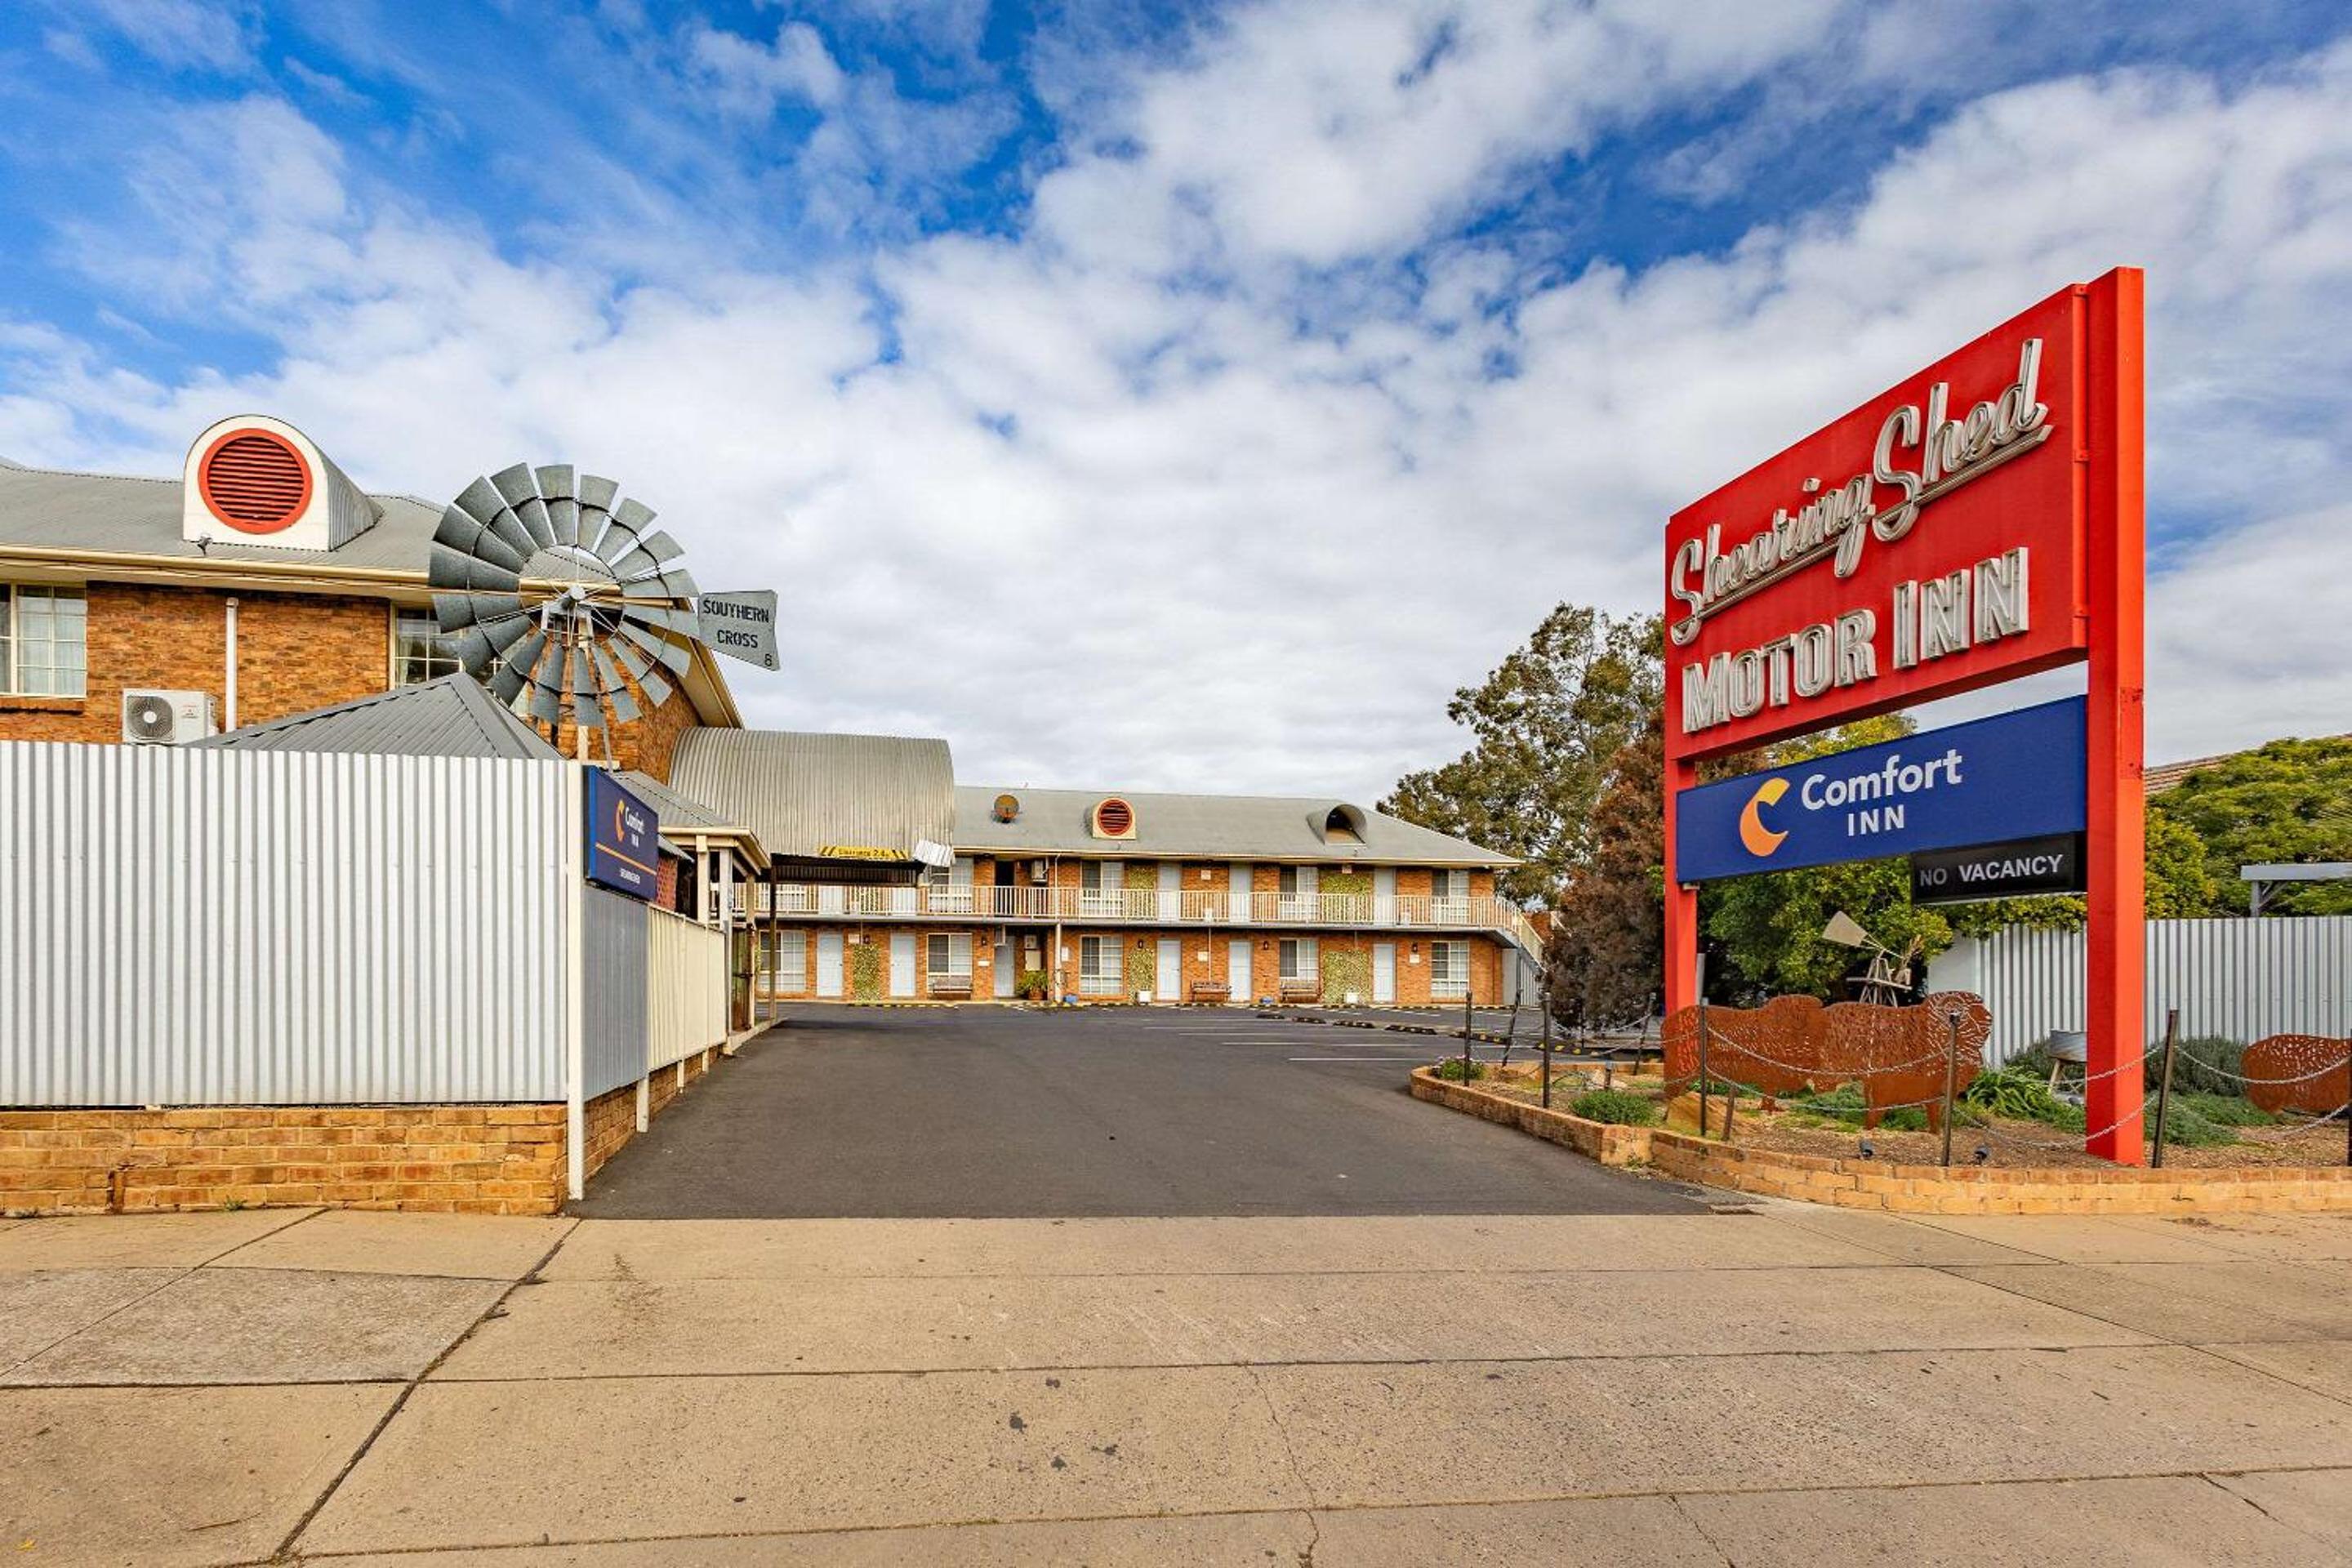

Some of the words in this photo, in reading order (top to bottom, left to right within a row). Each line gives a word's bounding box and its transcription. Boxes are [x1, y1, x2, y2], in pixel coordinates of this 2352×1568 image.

[1671, 476, 1876, 645] Shearing
[1873, 338, 2049, 541] Shed
[703, 599, 769, 623] SOUTHERN
[717, 630, 758, 648] CROSS
[1682, 608, 1877, 733] MOTOR
[1893, 547, 2029, 669] INN
[1802, 749, 1962, 810] Comfort
[1848, 804, 1904, 836] INN
[1920, 868, 1948, 886] NO
[1958, 854, 2064, 882] VACANCY
